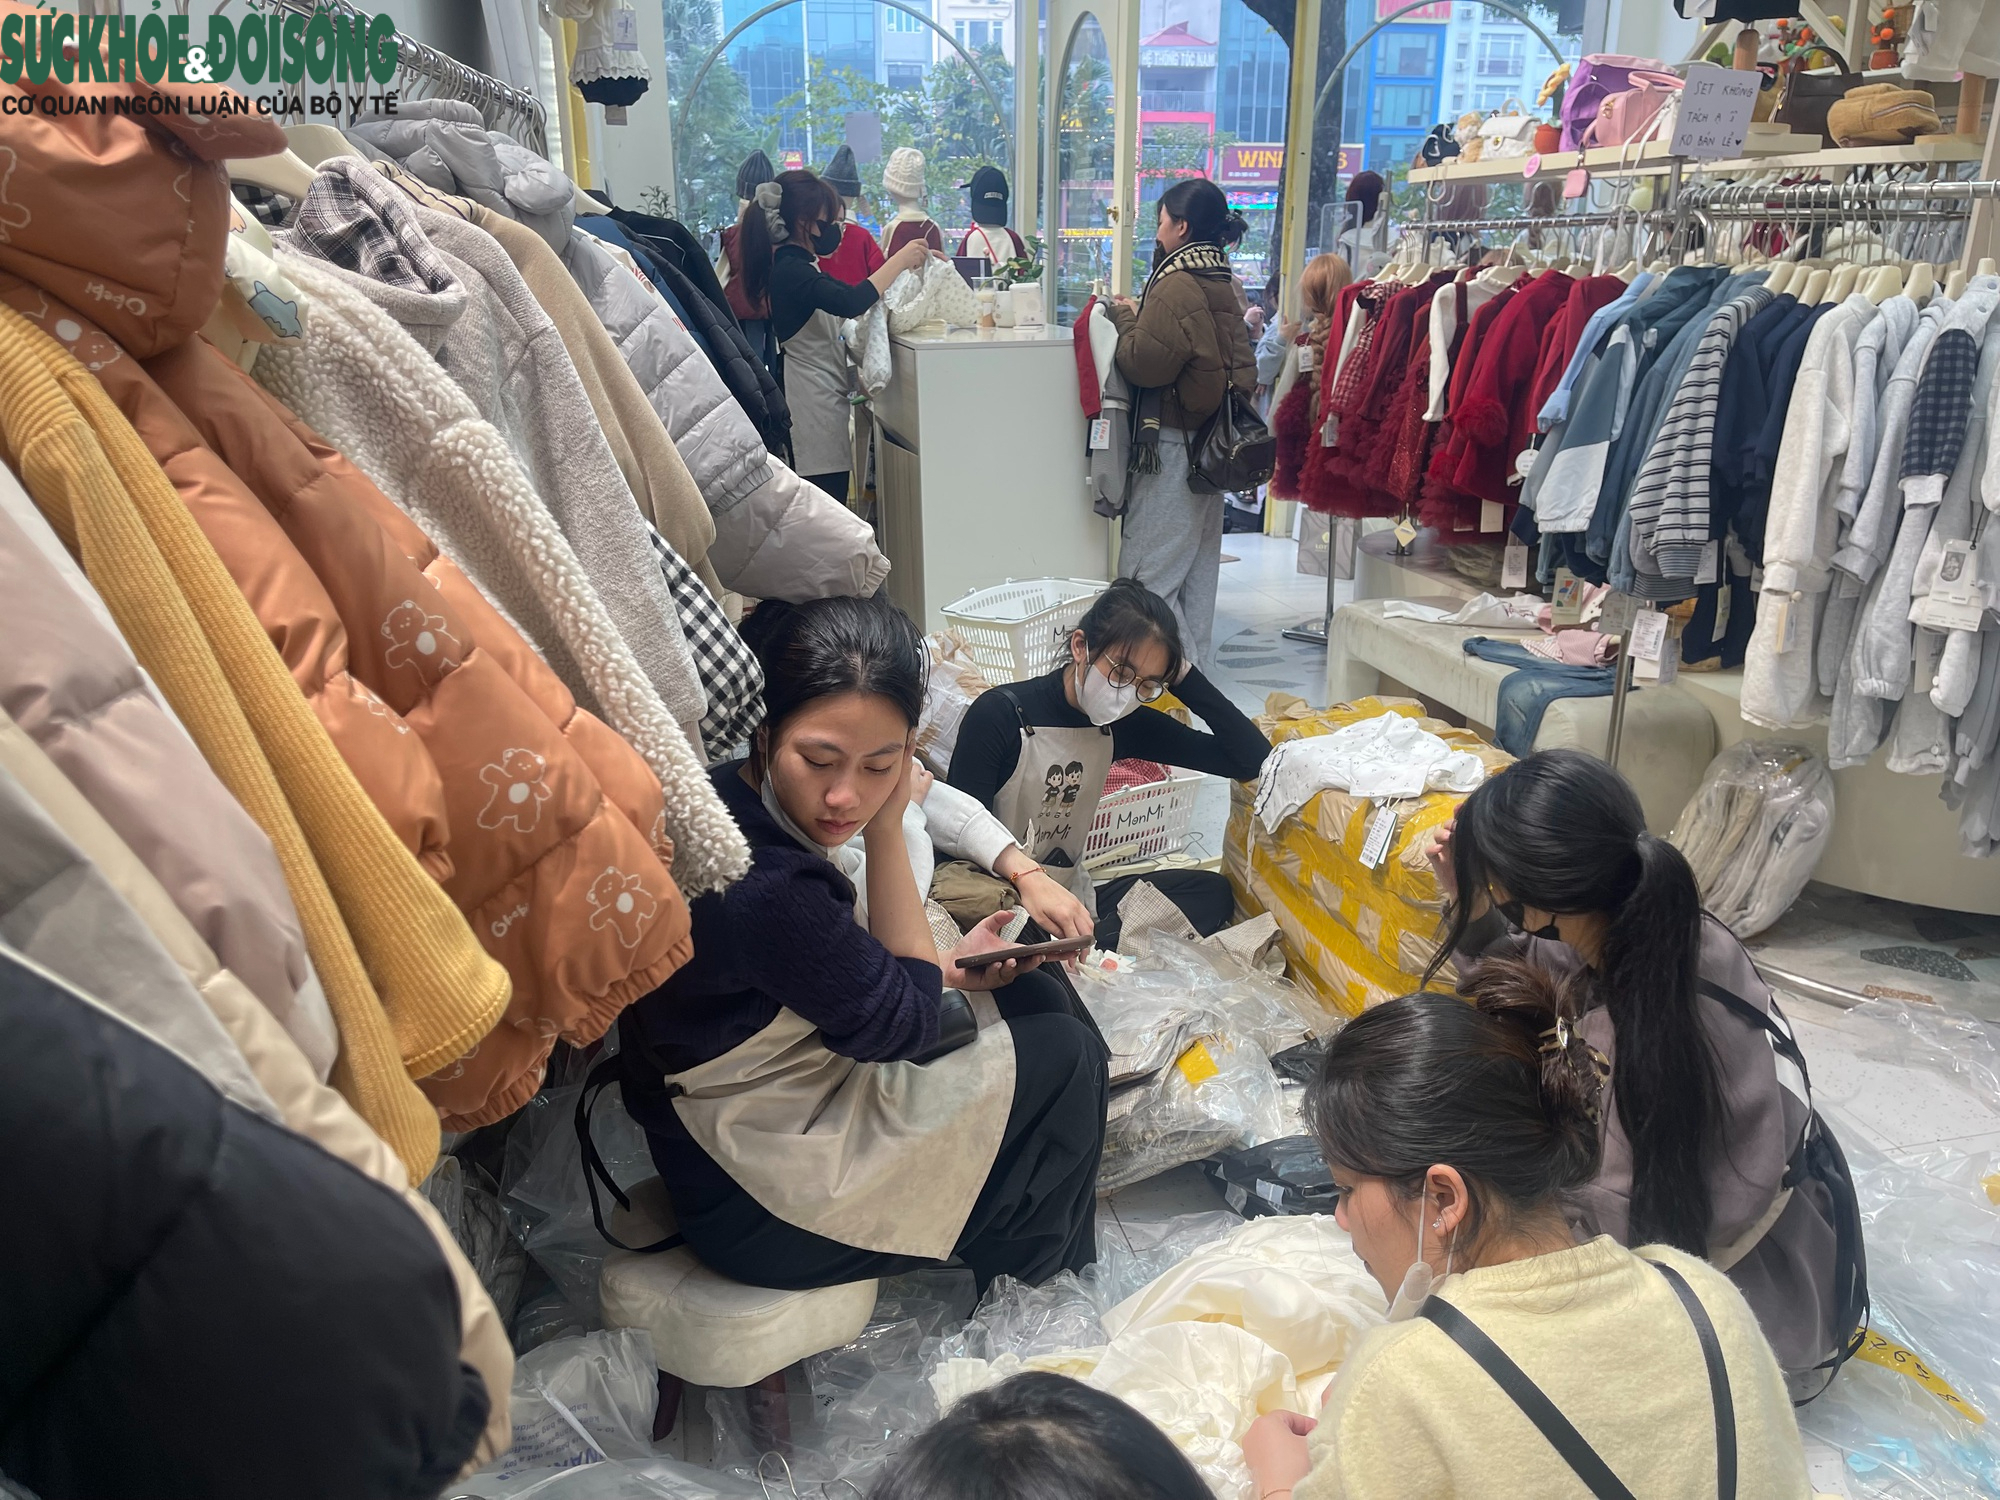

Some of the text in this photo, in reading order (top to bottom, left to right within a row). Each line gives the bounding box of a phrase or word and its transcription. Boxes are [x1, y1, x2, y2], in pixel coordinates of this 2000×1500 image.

[1694, 81, 1753, 98] SET KHÔNG
[1687, 107, 1708, 123] TÁCH
[1680, 131, 1734, 147] KO BÁN LẺ
[1116, 803, 1165, 830] MonMi
